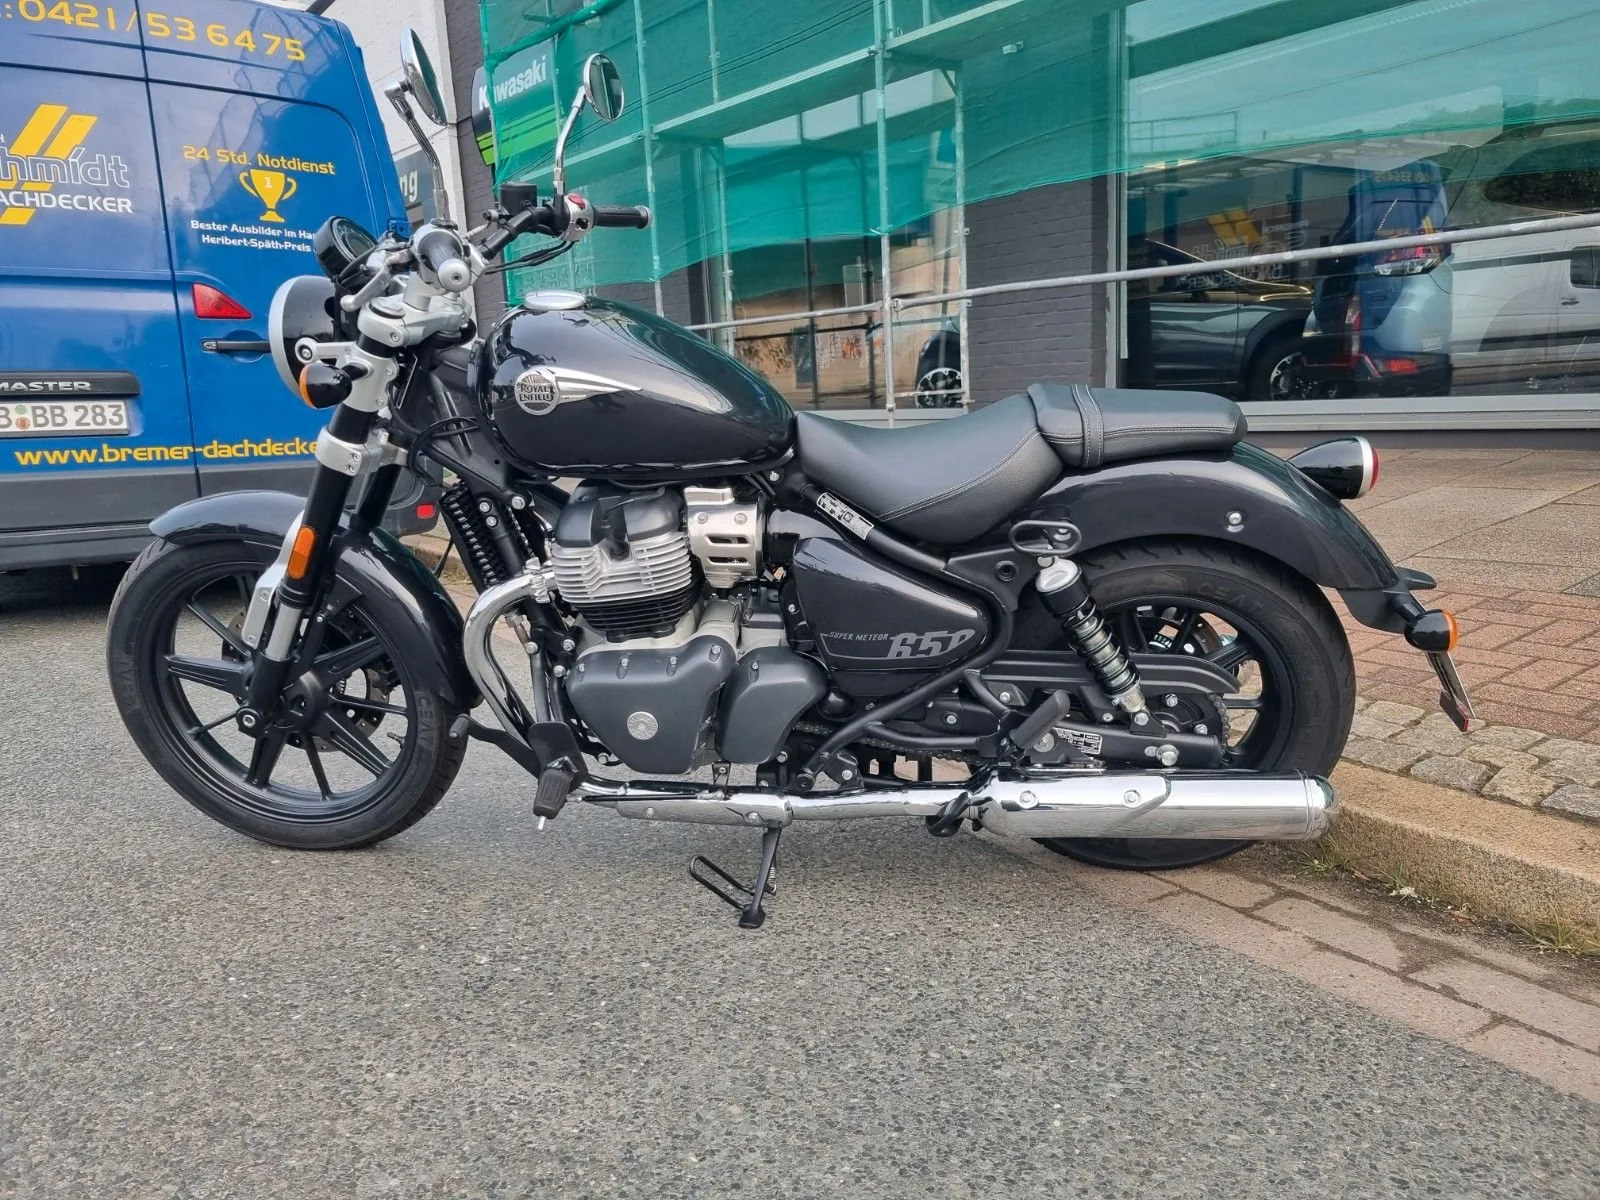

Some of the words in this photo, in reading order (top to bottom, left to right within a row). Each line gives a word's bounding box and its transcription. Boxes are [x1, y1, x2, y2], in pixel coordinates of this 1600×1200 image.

[478, 54, 547, 111] Kwasaki
[0, 147, 130, 188] hmidt
[183, 145, 210, 161] 24
[217, 149, 252, 167] Std.
[258, 153, 336, 176] Notdienst
[190, 219, 229, 232] Bester
[230, 223, 283, 237] Ausbilder
[284, 228, 297, 238] im
[298, 229, 316, 240] Ha
[516, 382, 555, 394] ROYAL
[519, 393, 554, 402] ENFIELD
[31, 405, 68, 428] BB
[75, 404, 125, 428] 283
[829, 631, 853, 641] SUPER
[855, 632, 889, 642] METEOR
